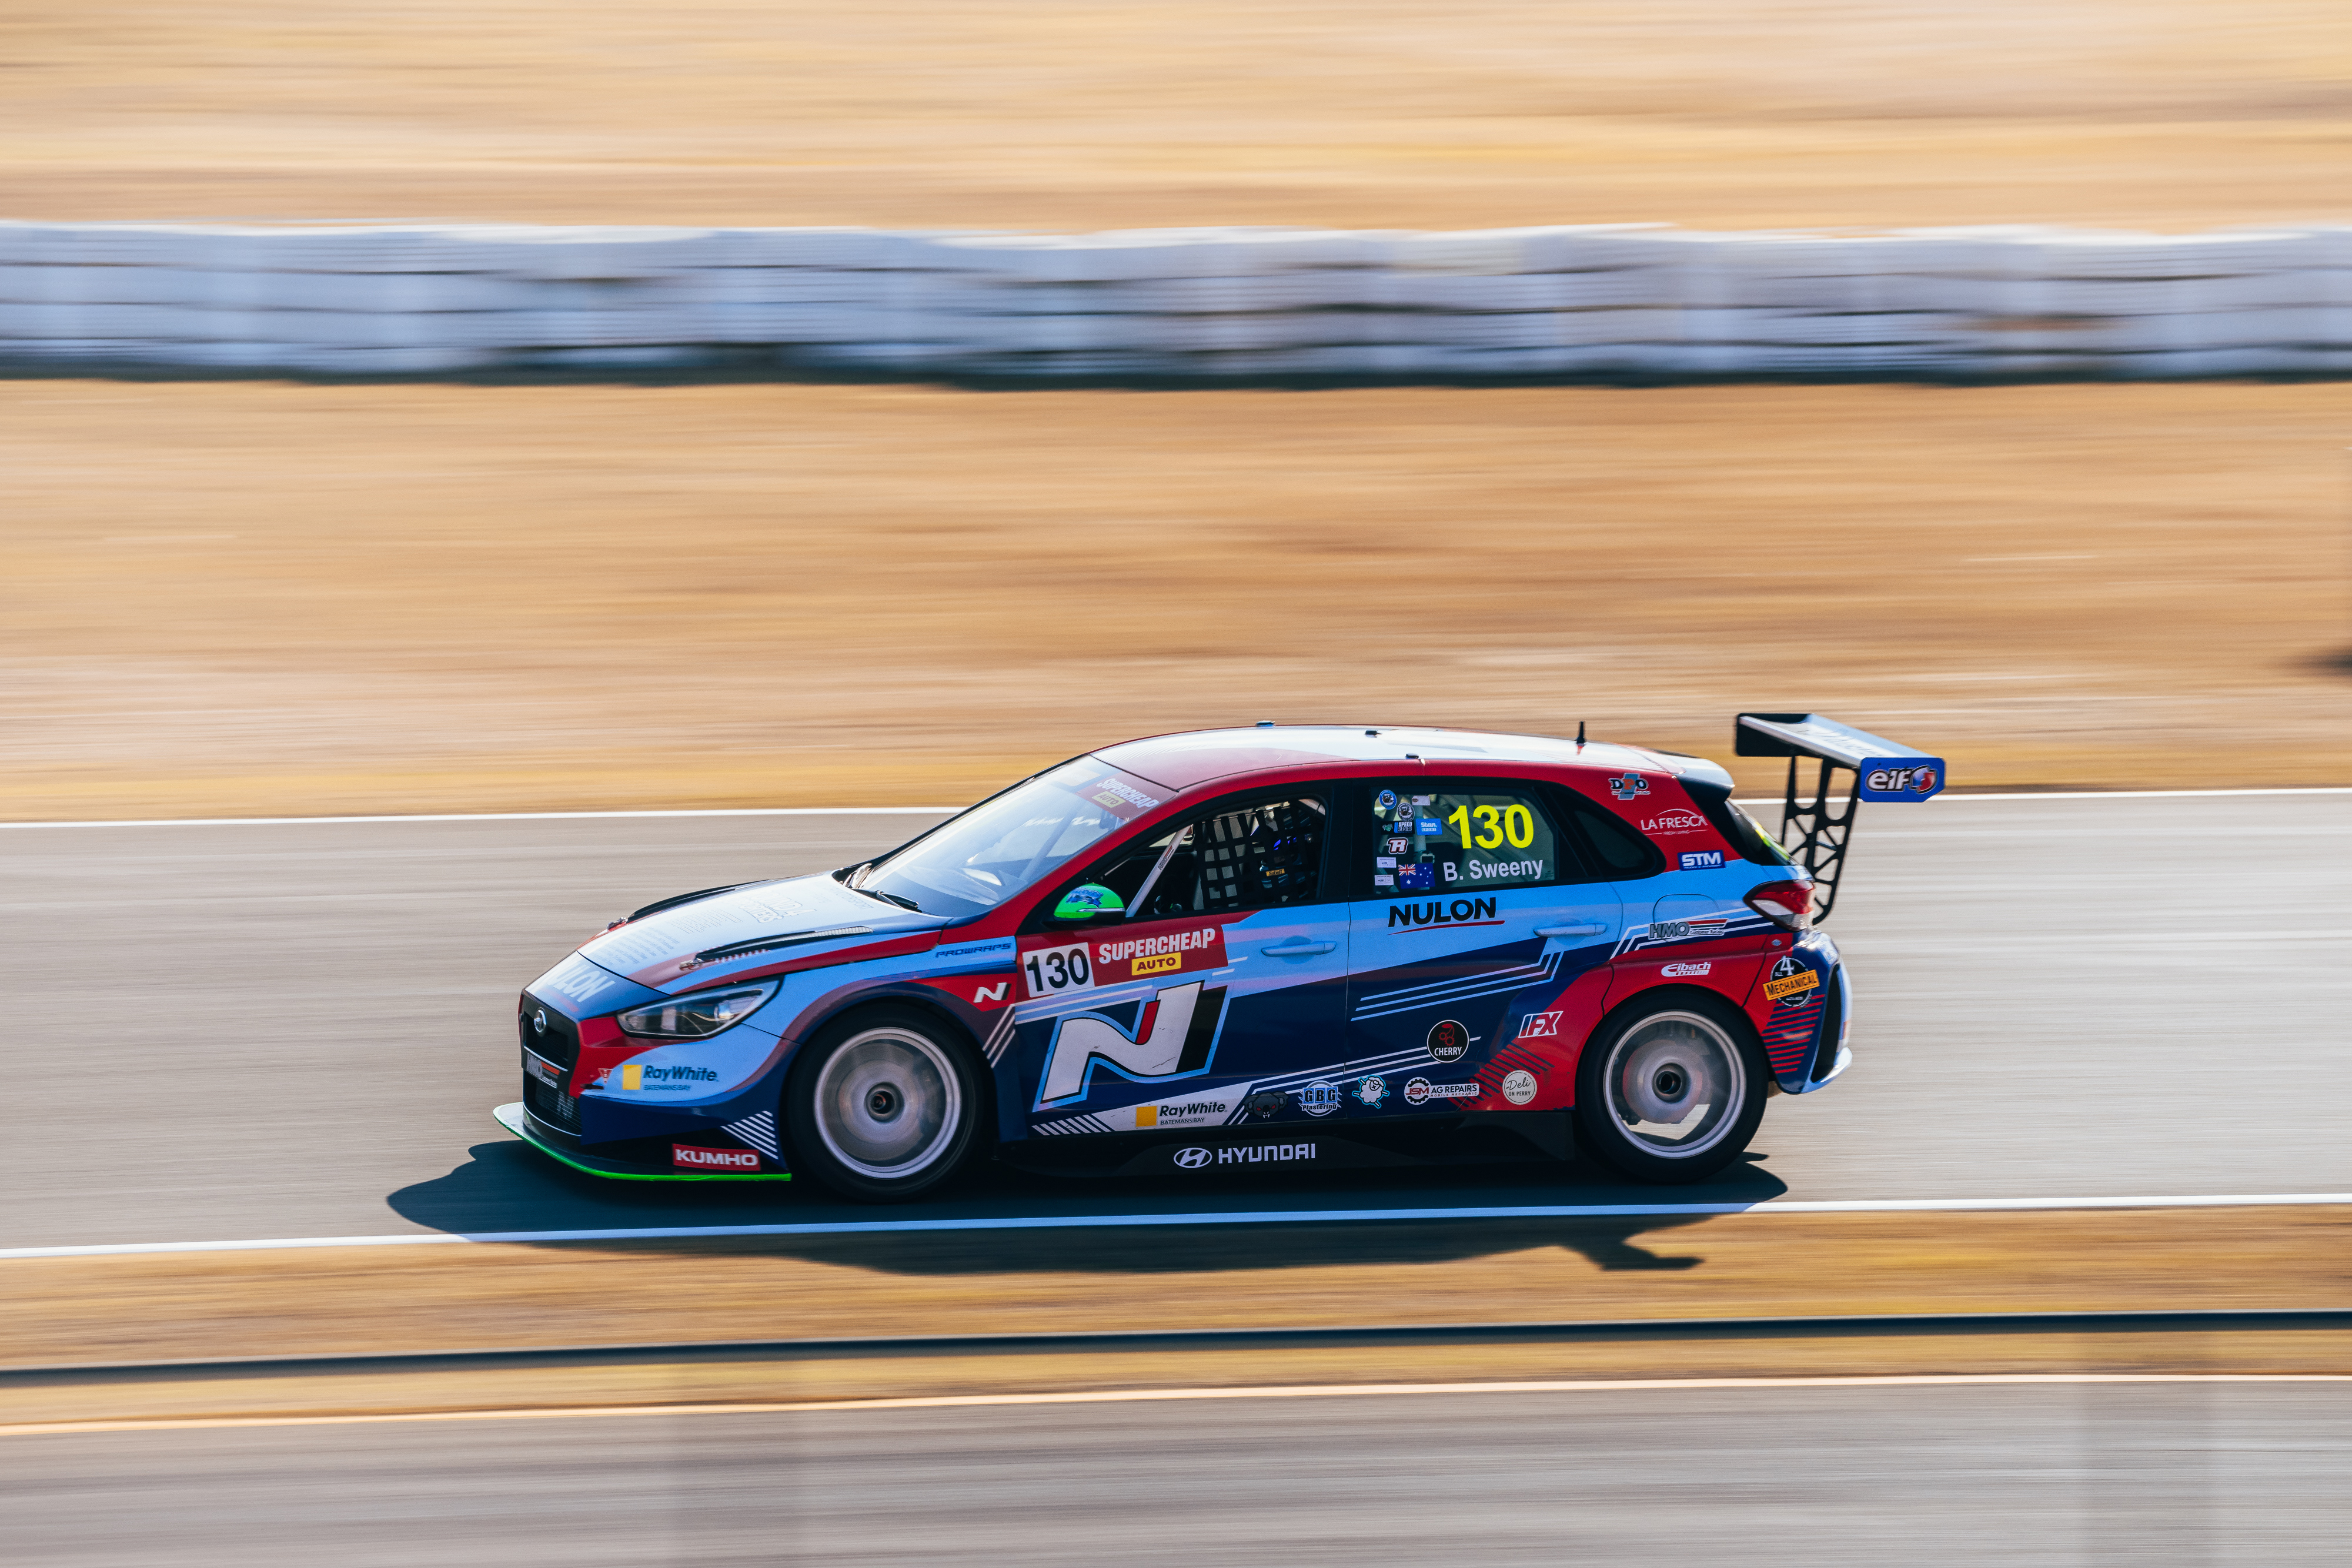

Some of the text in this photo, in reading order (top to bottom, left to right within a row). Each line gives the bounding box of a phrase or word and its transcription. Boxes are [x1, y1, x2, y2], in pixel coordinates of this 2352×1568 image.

[1609, 778, 1648, 790] DPO
[1866, 768, 1912, 791] elf
[1095, 778, 1160, 808] SUPERCHEAP
[1097, 793, 1120, 805] AUTO
[1448, 804, 1534, 850] 130
[1640, 815, 1708, 830] LA FRESCA
[1681, 852, 1721, 867] STM
[1443, 861, 1464, 881] B.
[1469, 859, 1544, 880] Sweeny
[1388, 897, 1496, 928] NULON
[1648, 921, 1690, 938] HMO
[935, 943, 1012, 958] PROWRAPS
[1098, 928, 1215, 964] SUPERCHEAP
[1027, 948, 1089, 992] 130
[1136, 957, 1177, 971] AUTO
[1661, 961, 1712, 977] Eibach
[1779, 955, 1795, 976] 4
[1434, 1047, 1462, 1057] CHERRY
[1405, 1086, 1429, 1095] JSM
[1445, 1084, 1477, 1093] REPAIRS
[1506, 1076, 1531, 1091] Deli
[1304, 1089, 1337, 1102] GBG
[1159, 1102, 1227, 1118] RayWhite
[675, 1149, 759, 1166] KUMHO
[1218, 1143, 1316, 1164] HYUNDAI
